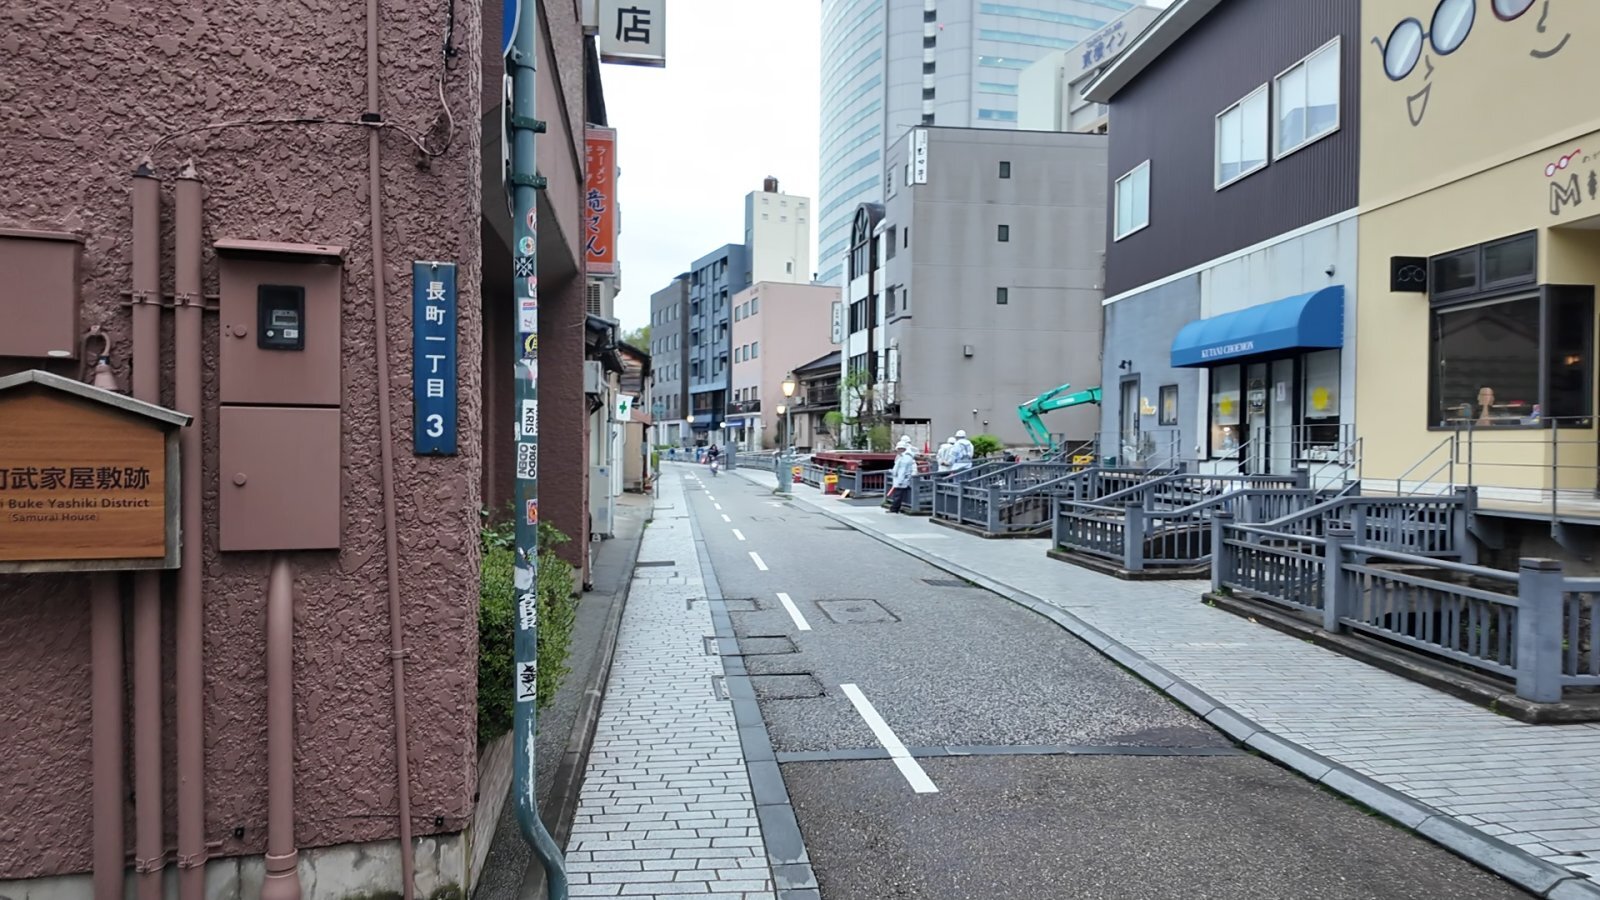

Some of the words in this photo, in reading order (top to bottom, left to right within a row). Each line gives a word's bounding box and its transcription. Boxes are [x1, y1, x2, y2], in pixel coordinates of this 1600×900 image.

[616, 6, 651, 44] 店
[425, 281, 447, 398] 長町一丁目
[426, 413, 444, 438] 3
[525, 407, 535, 434] KRIS
[9, 499, 44, 509] Buke
[48, 498, 97, 508] Yashiki
[101, 498, 150, 508] District
